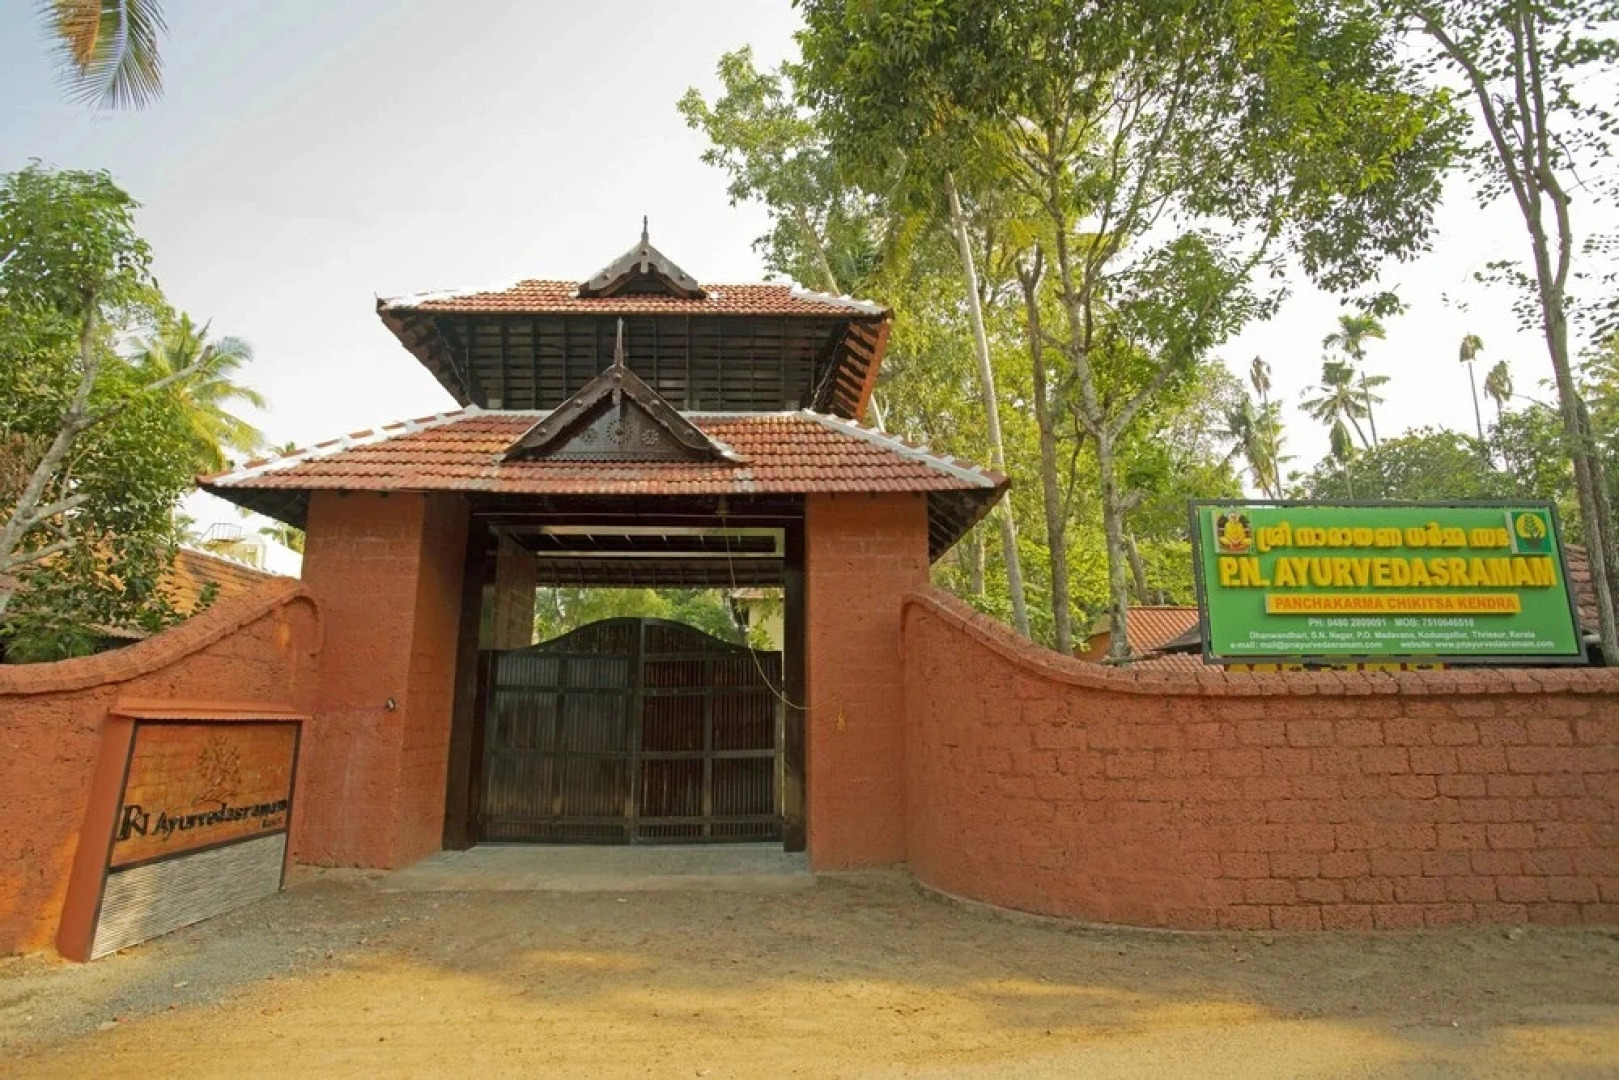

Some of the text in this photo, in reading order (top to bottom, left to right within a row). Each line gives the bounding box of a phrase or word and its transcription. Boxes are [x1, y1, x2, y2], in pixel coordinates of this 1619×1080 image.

[1219, 555, 1556, 588] P.N. AYURVEDASRAMAM
[1274, 597, 1516, 611] PANCHAKARMA CHIKITSA KENDRA
[1510, 631, 1536, 640] Kerala
